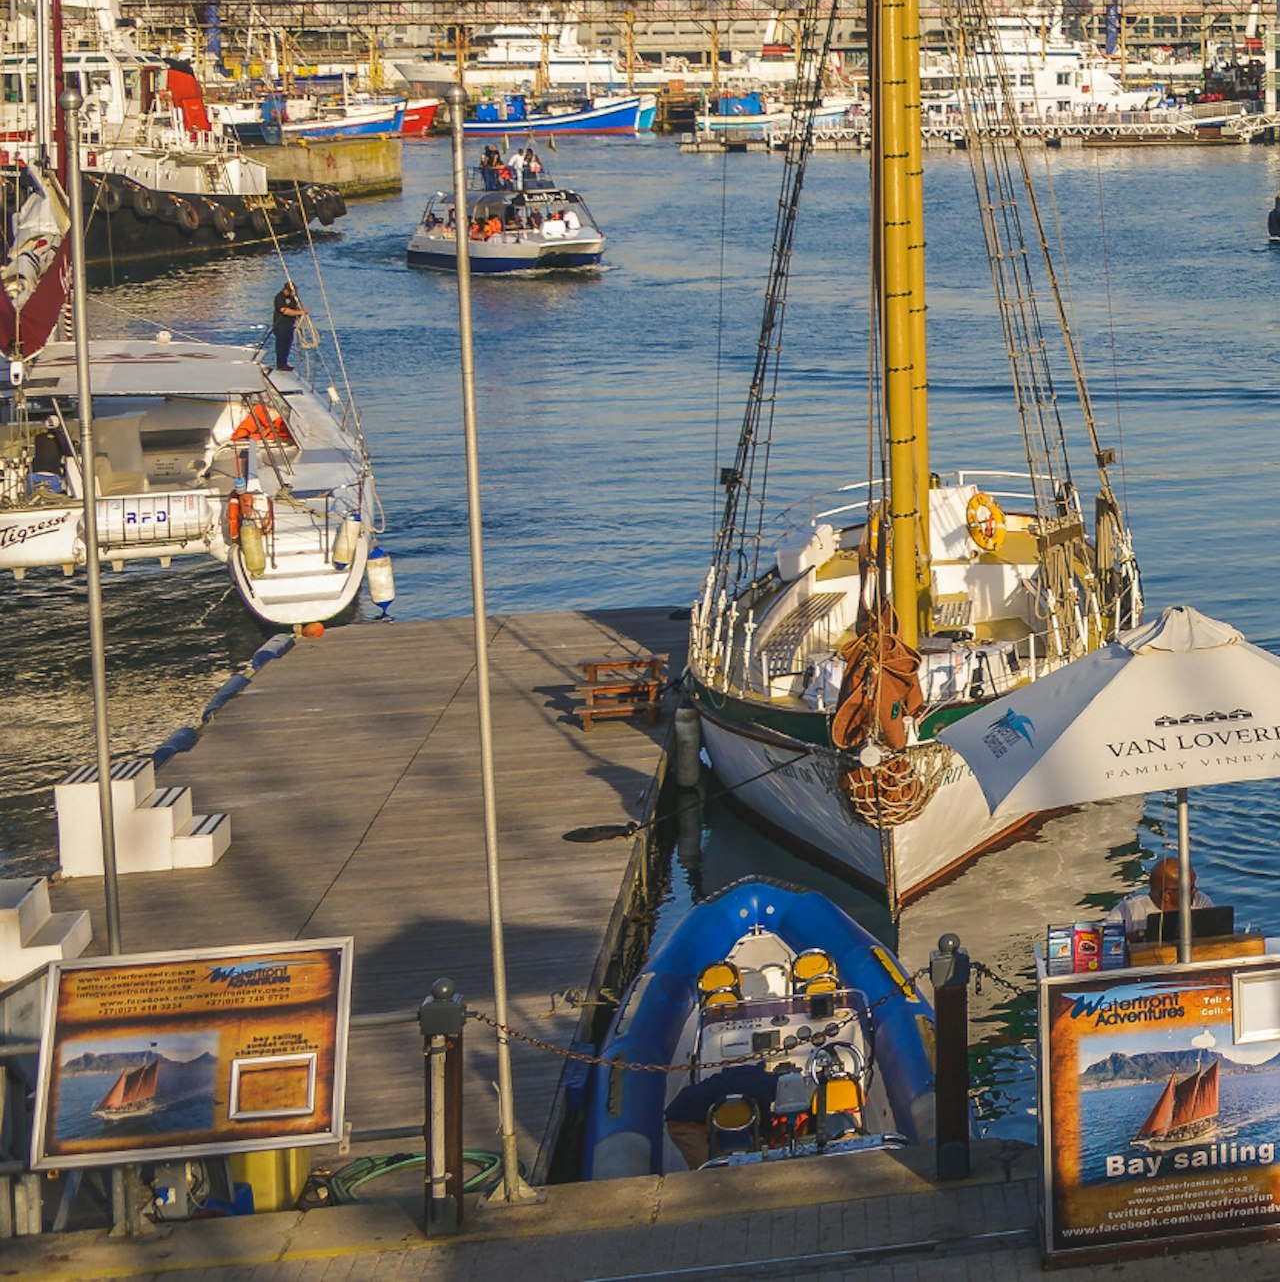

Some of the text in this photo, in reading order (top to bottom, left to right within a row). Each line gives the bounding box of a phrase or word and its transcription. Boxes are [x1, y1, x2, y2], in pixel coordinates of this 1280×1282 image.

[1106, 737, 1167, 758] VAN
[1105, 760, 1187, 779] FAMILY
[202, 965, 288, 984] Waterfront
[1063, 992, 1179, 1020] Waterfront
[1203, 996, 1222, 1005] Tel:
[1095, 1005, 1185, 1027] Adventures
[1201, 1008, 1224, 1016] Cell:
[234, 1043, 319, 1057] champagne cruise
[247, 1040, 277, 1049] sunset
[1106, 1142, 1275, 1177] Bay sailing
[1128, 1185, 1255, 1206] www.waterfrontadv.co.za
[1108, 1192, 1273, 1220] twitter.com/waterfrontfun
